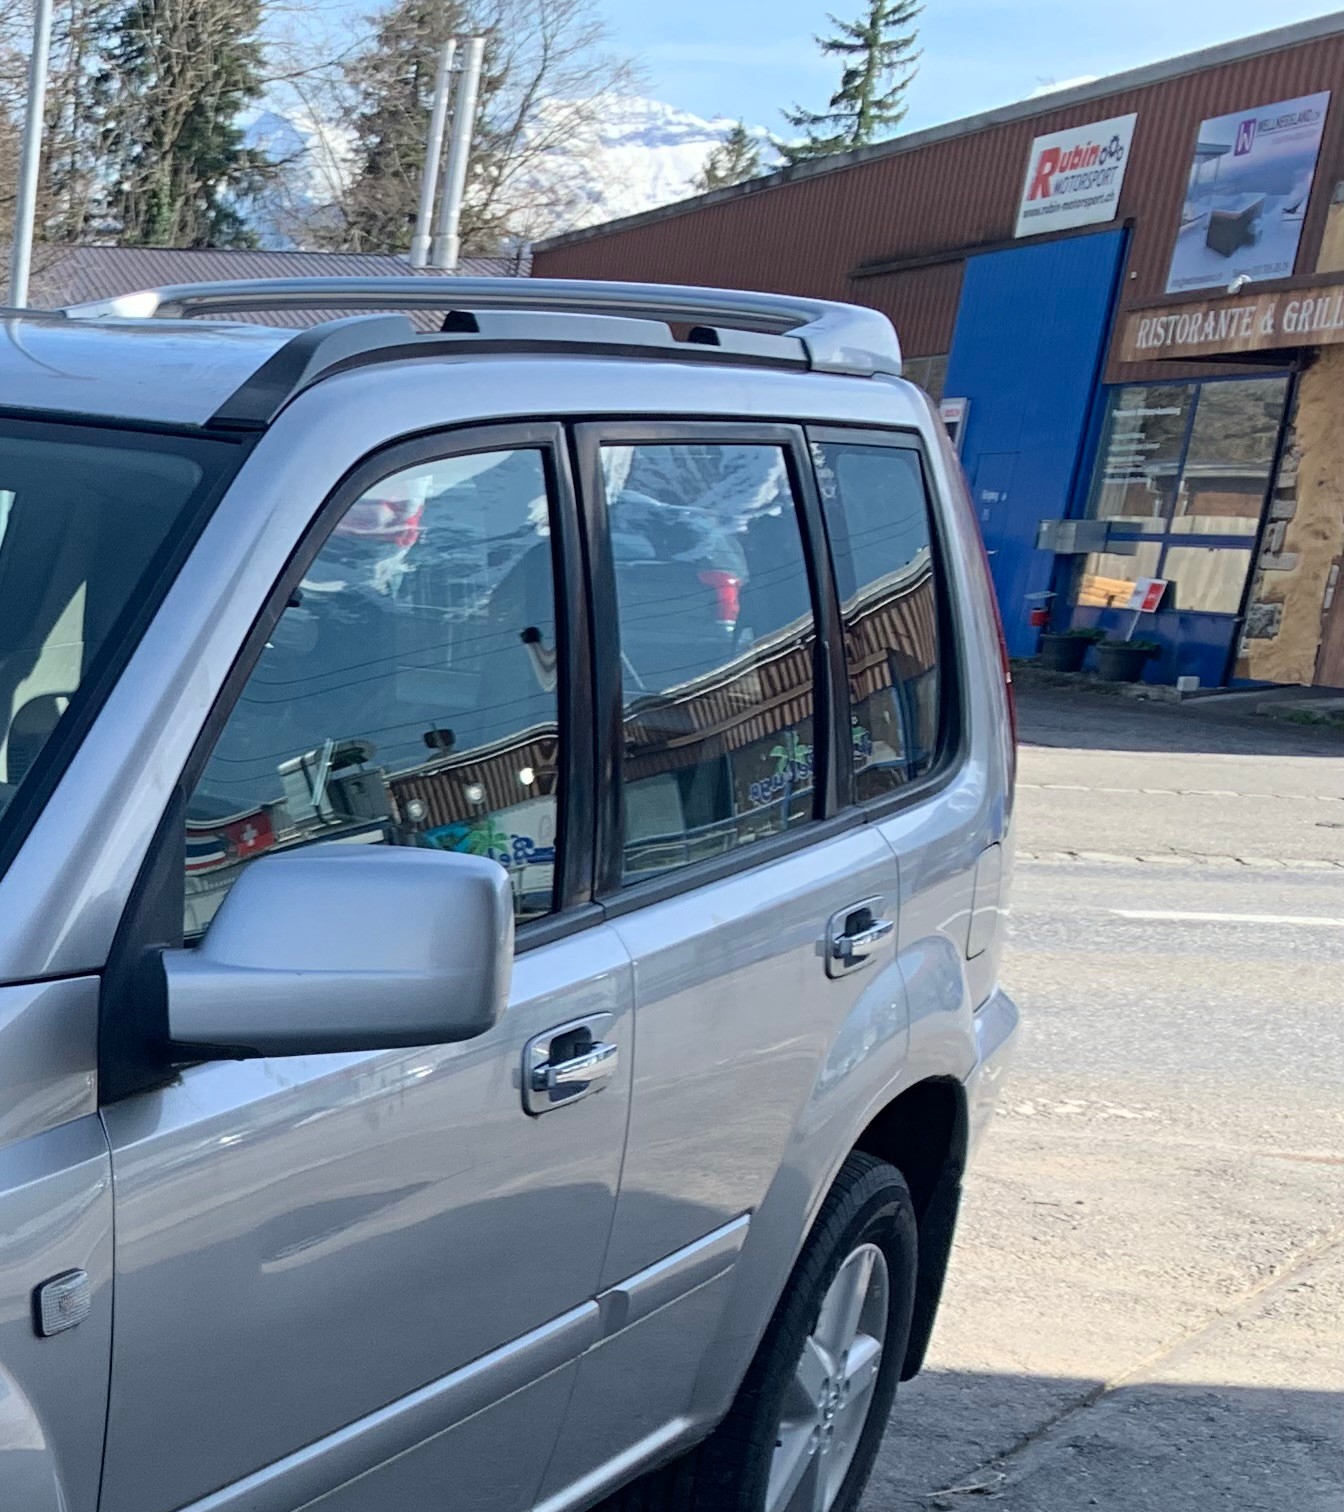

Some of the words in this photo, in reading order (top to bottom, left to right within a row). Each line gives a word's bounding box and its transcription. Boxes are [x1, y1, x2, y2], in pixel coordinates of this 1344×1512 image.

[1026, 141, 1101, 201] Rubin
[1136, 305, 1257, 349] RISTORANTE
[1261, 303, 1276, 335] &
